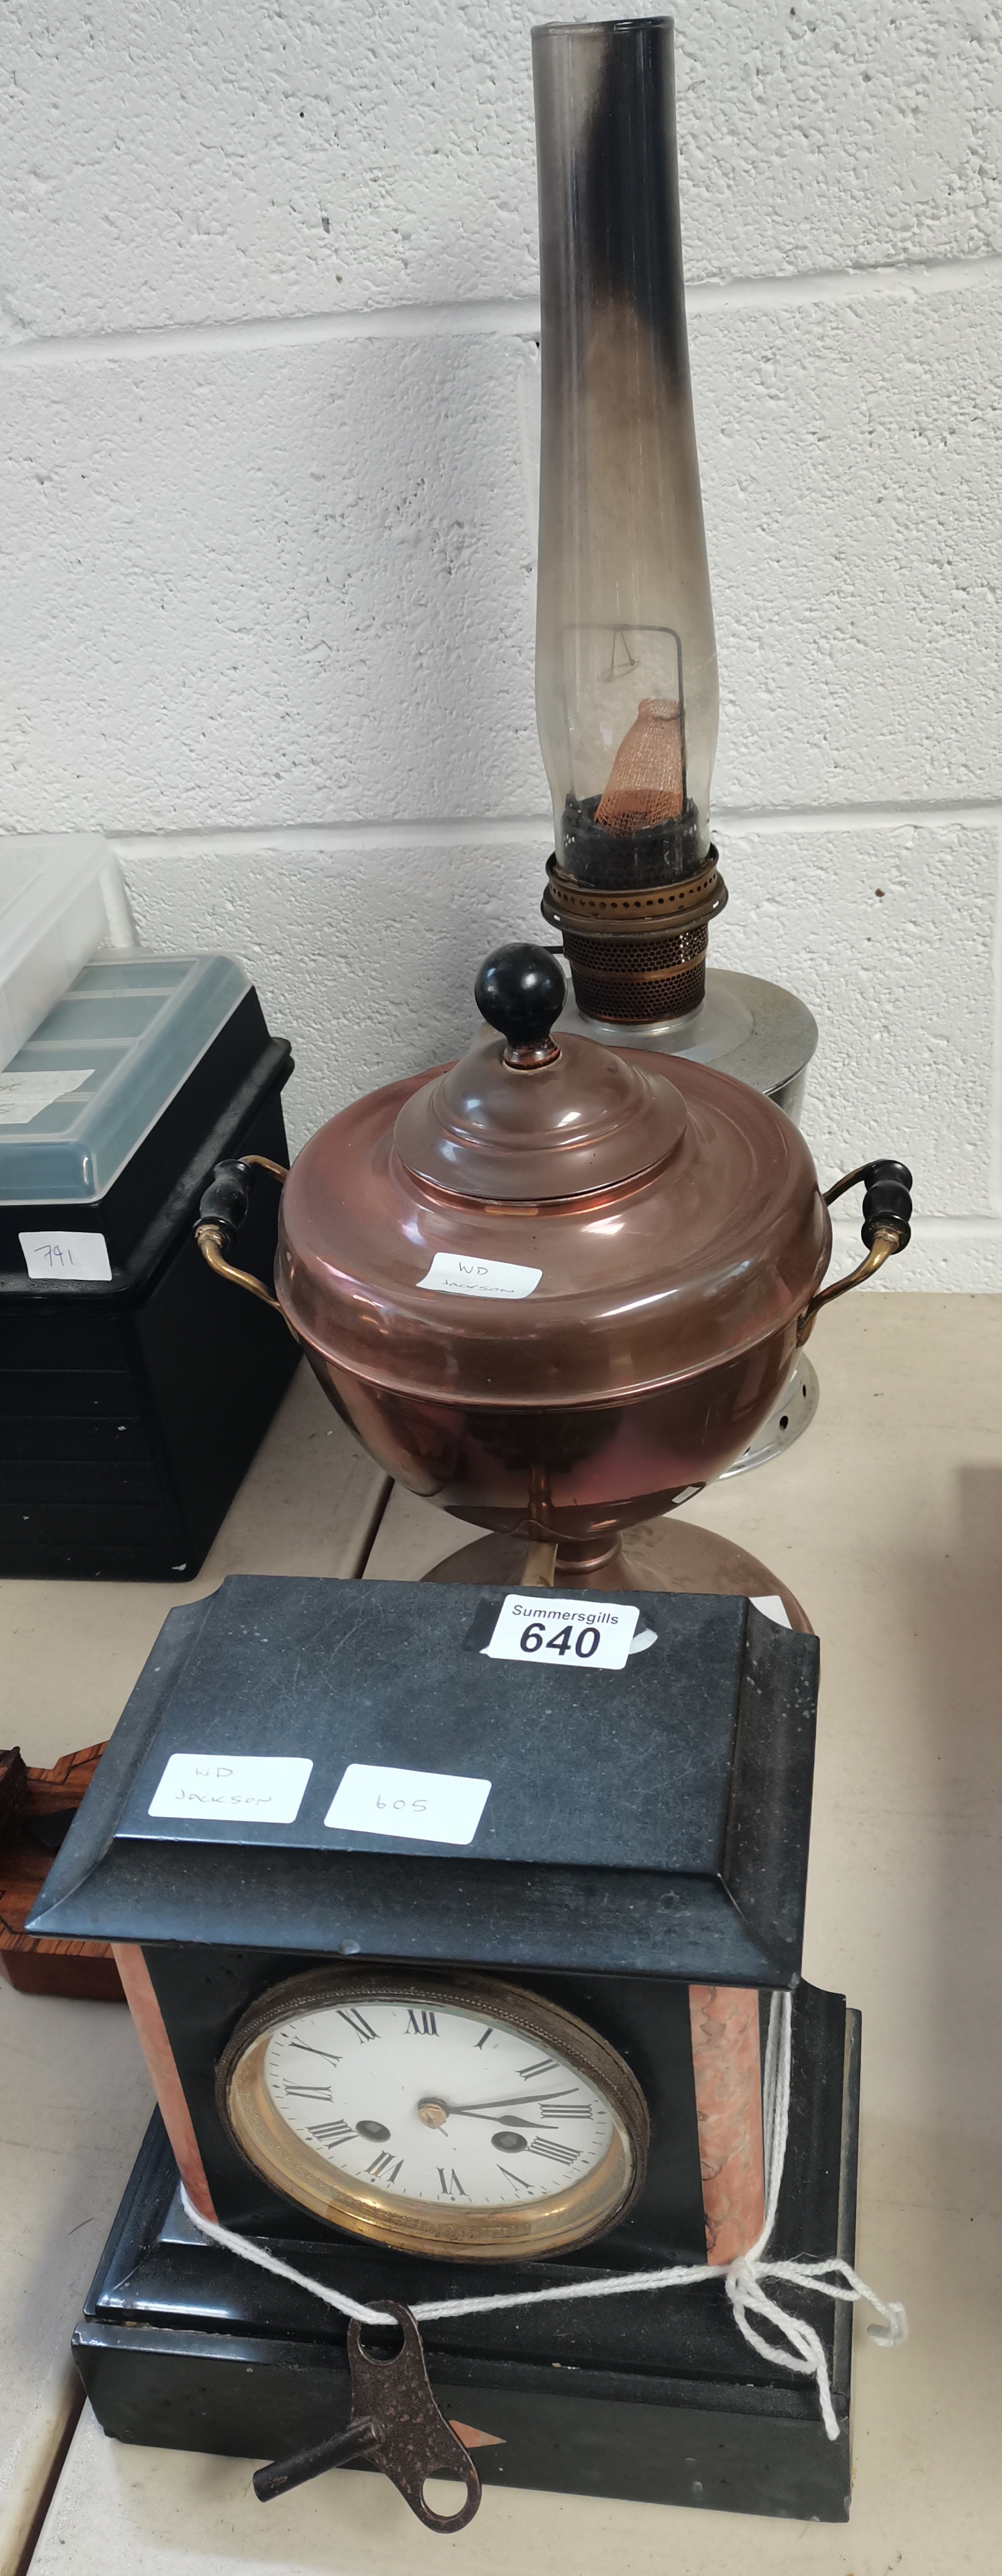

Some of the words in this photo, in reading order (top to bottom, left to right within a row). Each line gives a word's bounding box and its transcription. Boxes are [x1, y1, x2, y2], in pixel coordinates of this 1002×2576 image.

[459, 1261, 488, 1275] WD
[512, 1605, 619, 1624] Summersgills
[520, 1623, 601, 1658] 640
[175, 1789, 272, 1805] JACKSON
[376, 1794, 427, 1812] 605
[336, 2008, 381, 2044] XI
[404, 2009, 439, 2036] XII
[288, 2036, 343, 2067] X
[474, 2027, 494, 2050] I
[515, 2059, 560, 2080] II
[283, 2078, 333, 2103] IX
[538, 2103, 594, 2120] III
[306, 2118, 360, 2149] VIII
[523, 2136, 583, 2165] IIII
[364, 2149, 405, 2184] VII
[496, 2164, 534, 2191] V
[436, 2166, 468, 2196] VI
